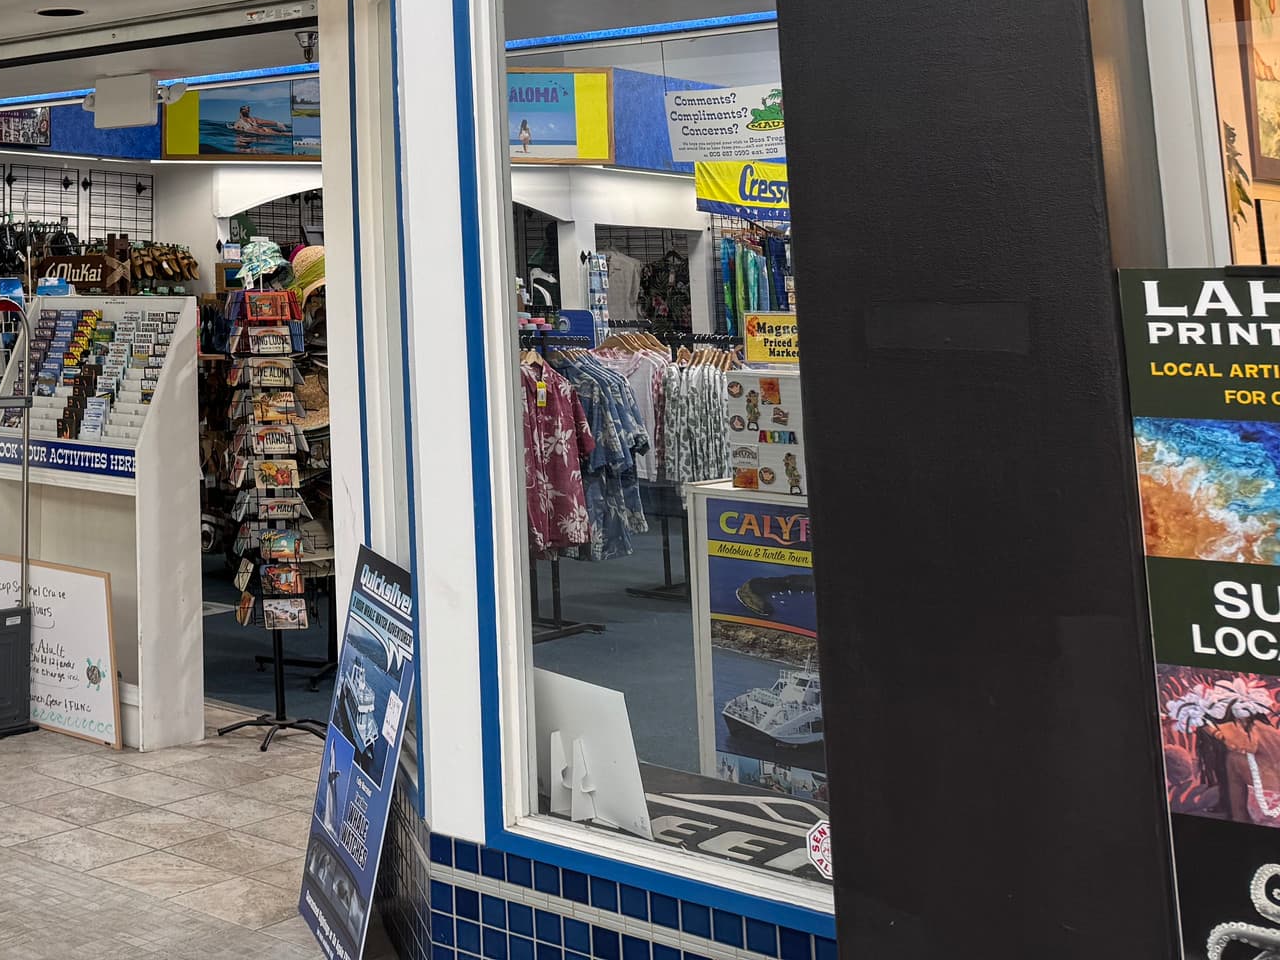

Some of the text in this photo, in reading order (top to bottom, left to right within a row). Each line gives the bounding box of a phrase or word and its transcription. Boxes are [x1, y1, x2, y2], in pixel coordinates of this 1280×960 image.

[509, 86, 560, 103] ALOHA
[674, 92, 737, 107] Comments?
[670, 107, 748, 124] Compliments?
[681, 123, 739, 136] Concerns?
[763, 339, 792, 348] Priced
[1150, 362, 1223, 377] LOCAL
[1224, 390, 1267, 405] FOR
[21, 444, 47, 462] OUR
[49, 448, 107, 469] ACTIVITIES
[717, 544, 810, 564] Molokini & Turtle Town
[42, 587, 66, 599] Cruse
[36, 638, 65, 658] Adult
[1191, 623, 1280, 661] LOC
